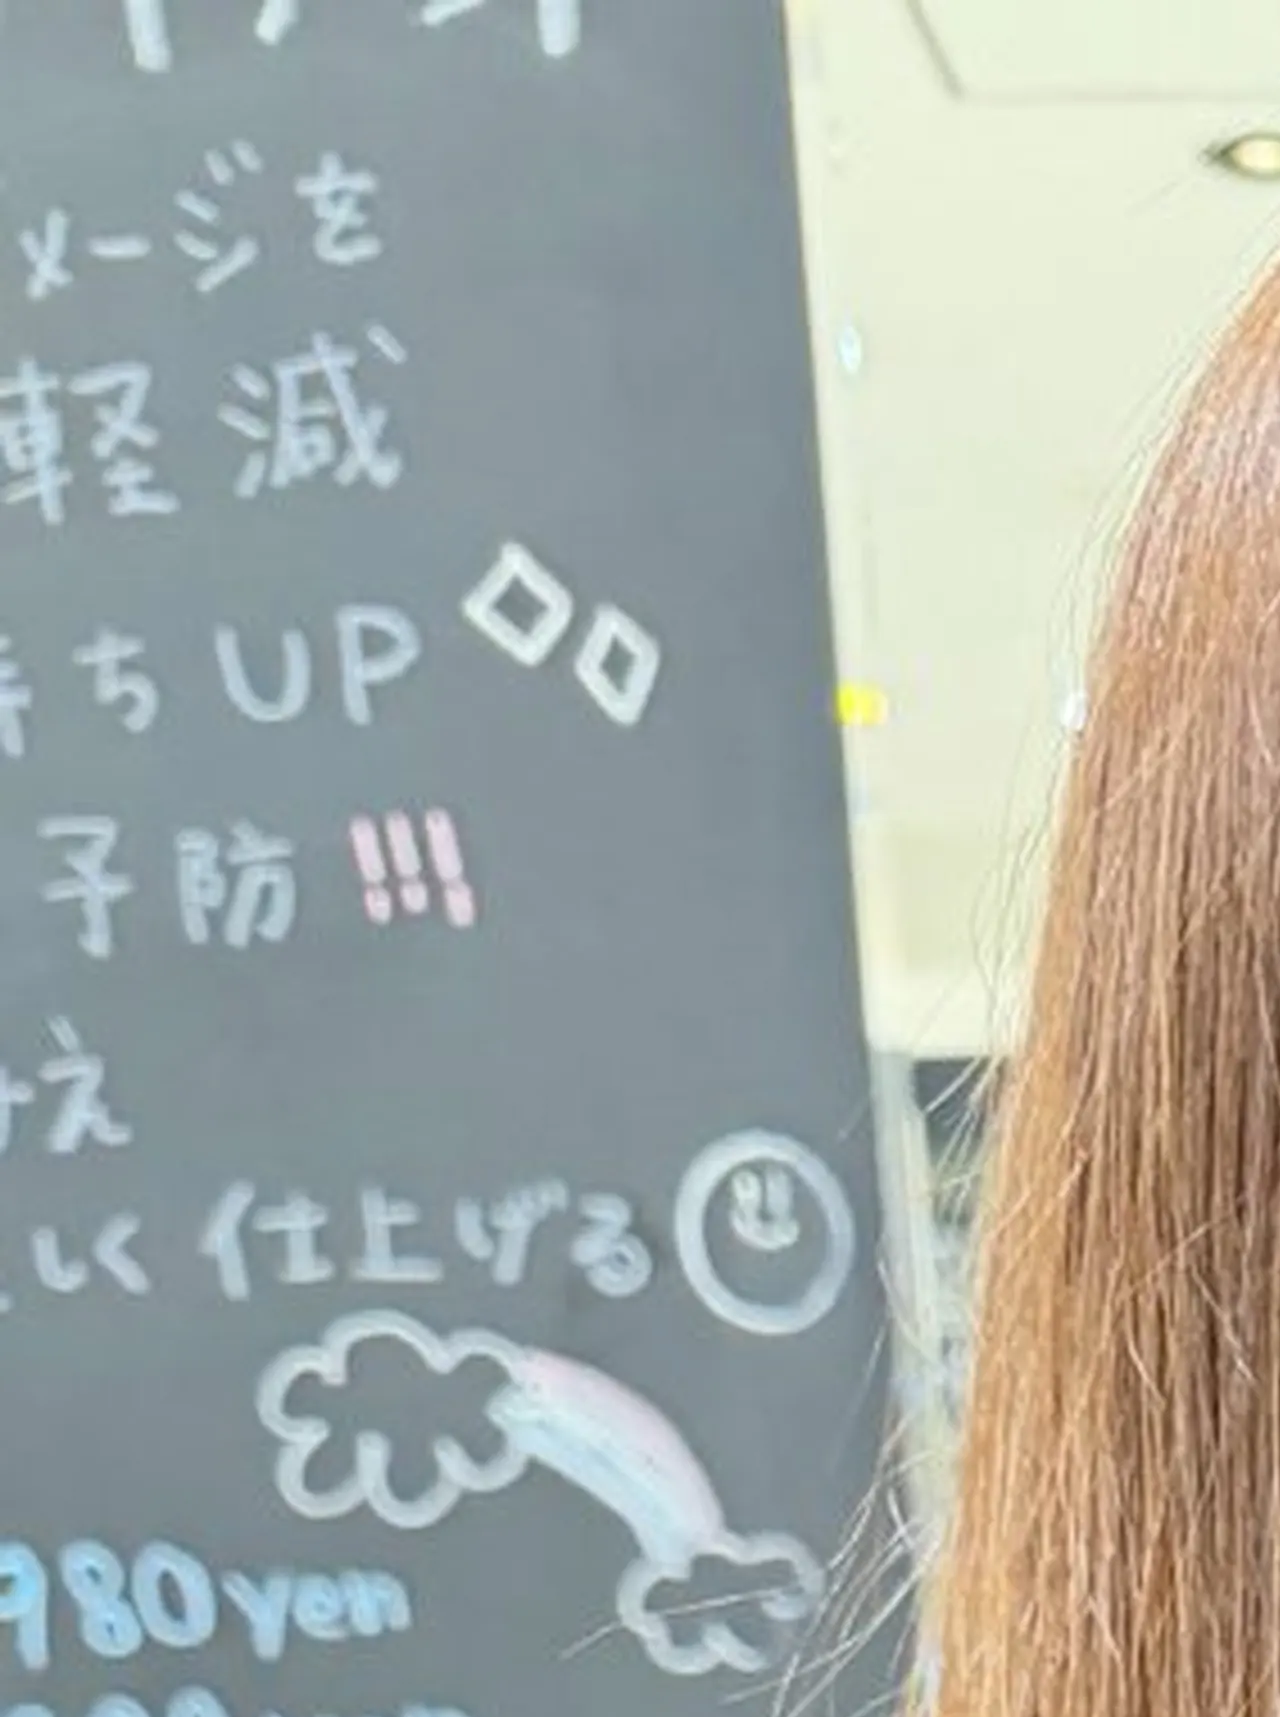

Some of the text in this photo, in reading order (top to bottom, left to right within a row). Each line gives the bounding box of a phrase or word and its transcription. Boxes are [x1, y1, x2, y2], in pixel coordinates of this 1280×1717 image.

[0, 320, 406, 526] 軽減
[0, 1178, 654, 1314] しく仕上げる
